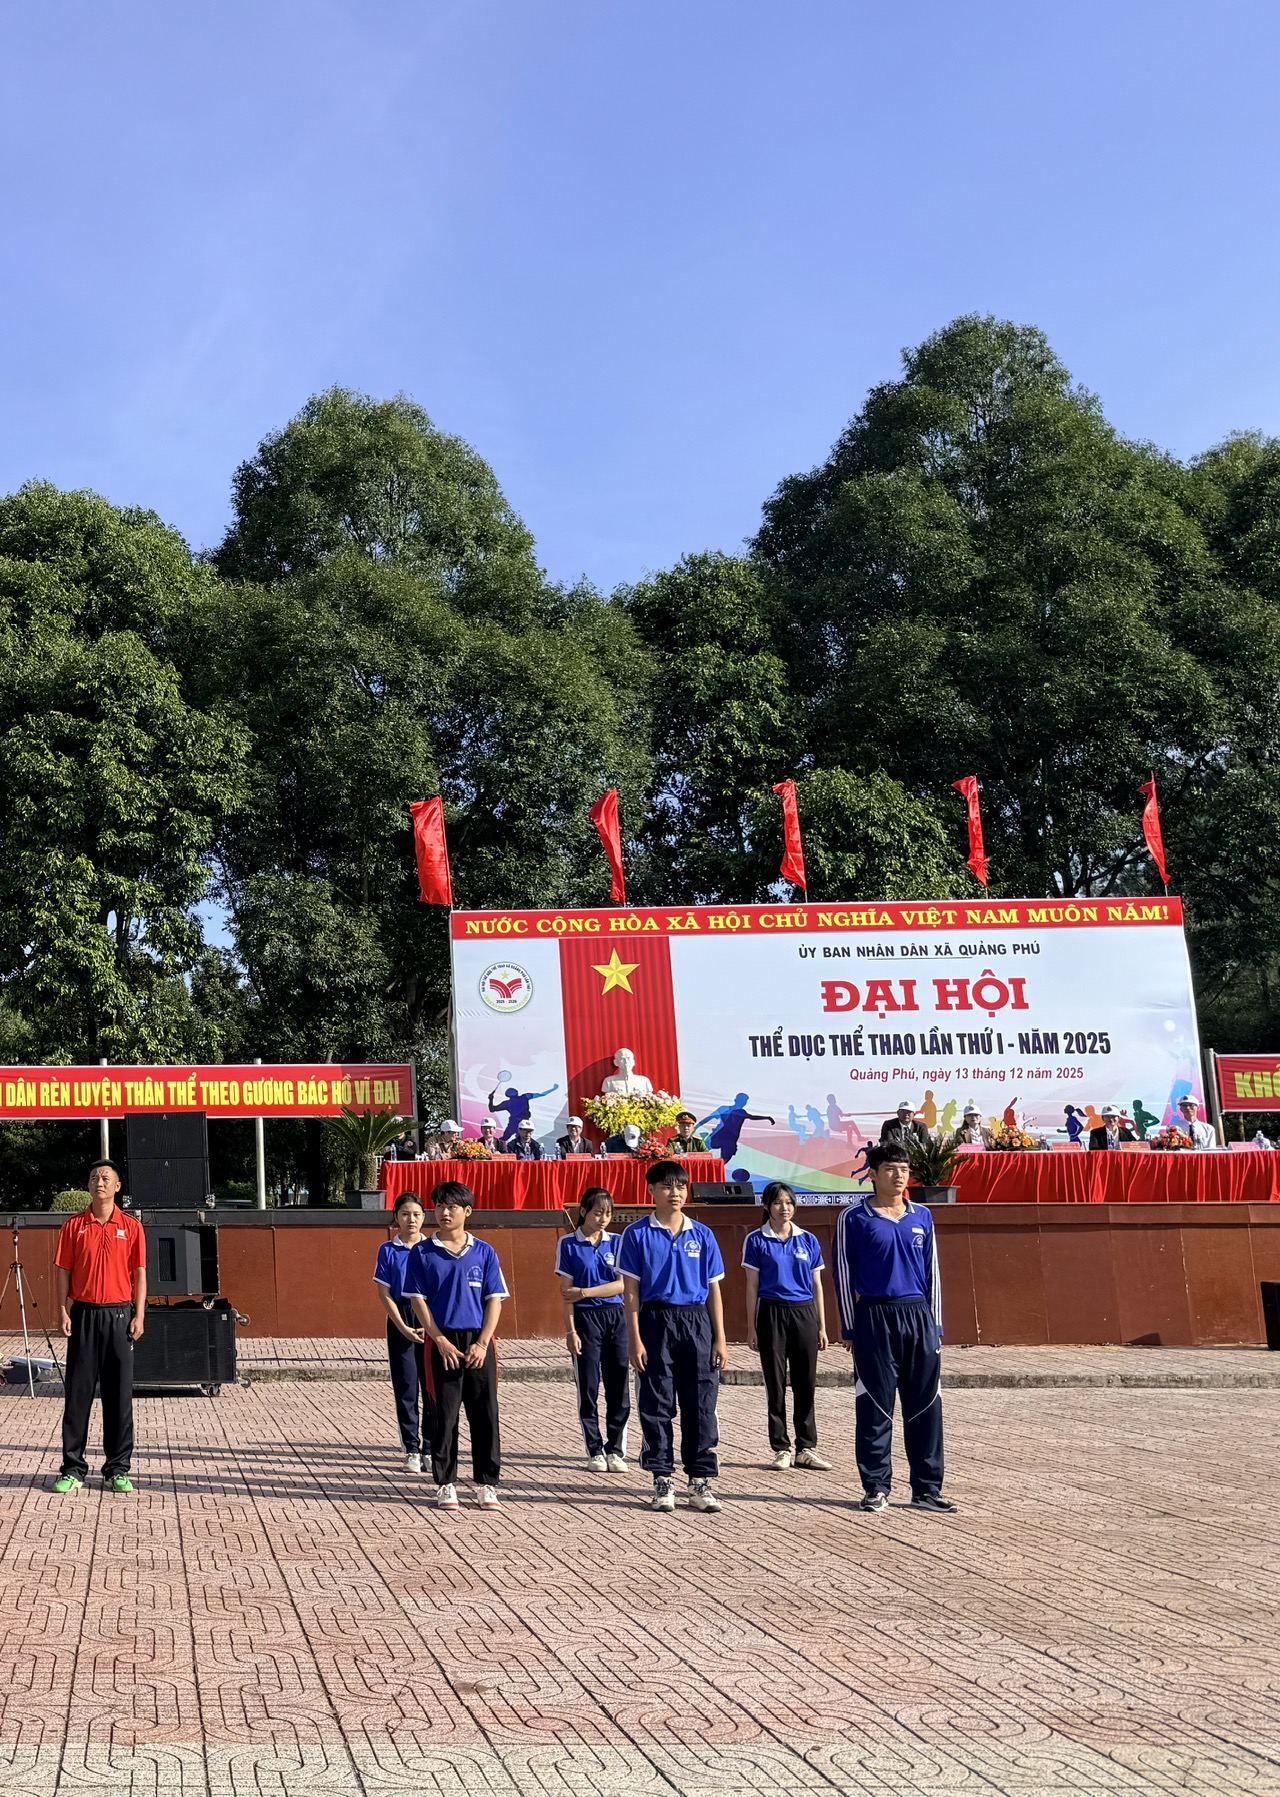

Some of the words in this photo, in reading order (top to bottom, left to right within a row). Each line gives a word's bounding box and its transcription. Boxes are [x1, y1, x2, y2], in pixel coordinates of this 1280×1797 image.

[465, 916, 529, 934] NƯỚC
[536, 915, 601, 936] CỘNG
[608, 912, 660, 932] HÒA
[665, 911, 701, 930] XÃ
[707, 910, 751, 932] HỘI
[759, 907, 809, 929] CHỦ
[817, 907, 895, 928] NGHĨA
[899, 906, 958, 928] VIỆT
[966, 908, 1020, 924] NAM
[1026, 904, 1098, 923] MUÔN
[1107, 902, 1169, 921] NĂM!
[798, 943, 817, 959] ỦY
[823, 946, 851, 958] BAN
[857, 944, 895, 958] NHÂN
[901, 943, 929, 957] DÂN
[934, 942, 953, 957] XÃ
[959, 940, 1007, 958] QUẢNG
[1013, 940, 1040, 955] PHÚ
[821, 979, 919, 1019] ĐẠI
[932, 968, 1029, 1018] HỘI
[748, 1026, 785, 1057] THỂ
[788, 1034, 826, 1061] DỤC
[829, 1024, 865, 1056] THỂ
[868, 1033, 916, 1056] THAO
[920, 1026, 954, 1055] LẦN
[956, 1026, 994, 1055] THỨ
[996, 1033, 1004, 1054] I
[1018, 1028, 1060, 1054] NĂM
[1063, 1031, 1111, 1054] 2025
[6, 1077, 36, 1106] DÂN
[40, 1076, 70, 1106] RÈN
[74, 1076, 121, 1111] LUYỆN
[124, 1076, 165, 1106] THÂN
[168, 1072, 197, 1105] THỂ
[200, 1080, 240, 1105] THEO
[243, 1077, 294, 1105] GƯƠNG
[297, 1075, 328, 1105] BÁC
[331, 1073, 352, 1105] HỒ
[355, 1076, 371, 1105] VĨ
[374, 1080, 400, 1109] ĐẠI
[849, 1067, 889, 1082] Quảng
[892, 1067, 919, 1081] Phú,
[922, 1068, 951, 1082] ngày
[955, 1068, 969, 1079] 13
[972, 1067, 1006, 1081] tháng
[1009, 1068, 1024, 1078] 12
[1027, 1067, 1052, 1079] năm
[1056, 1067, 1084, 1079] 2025
